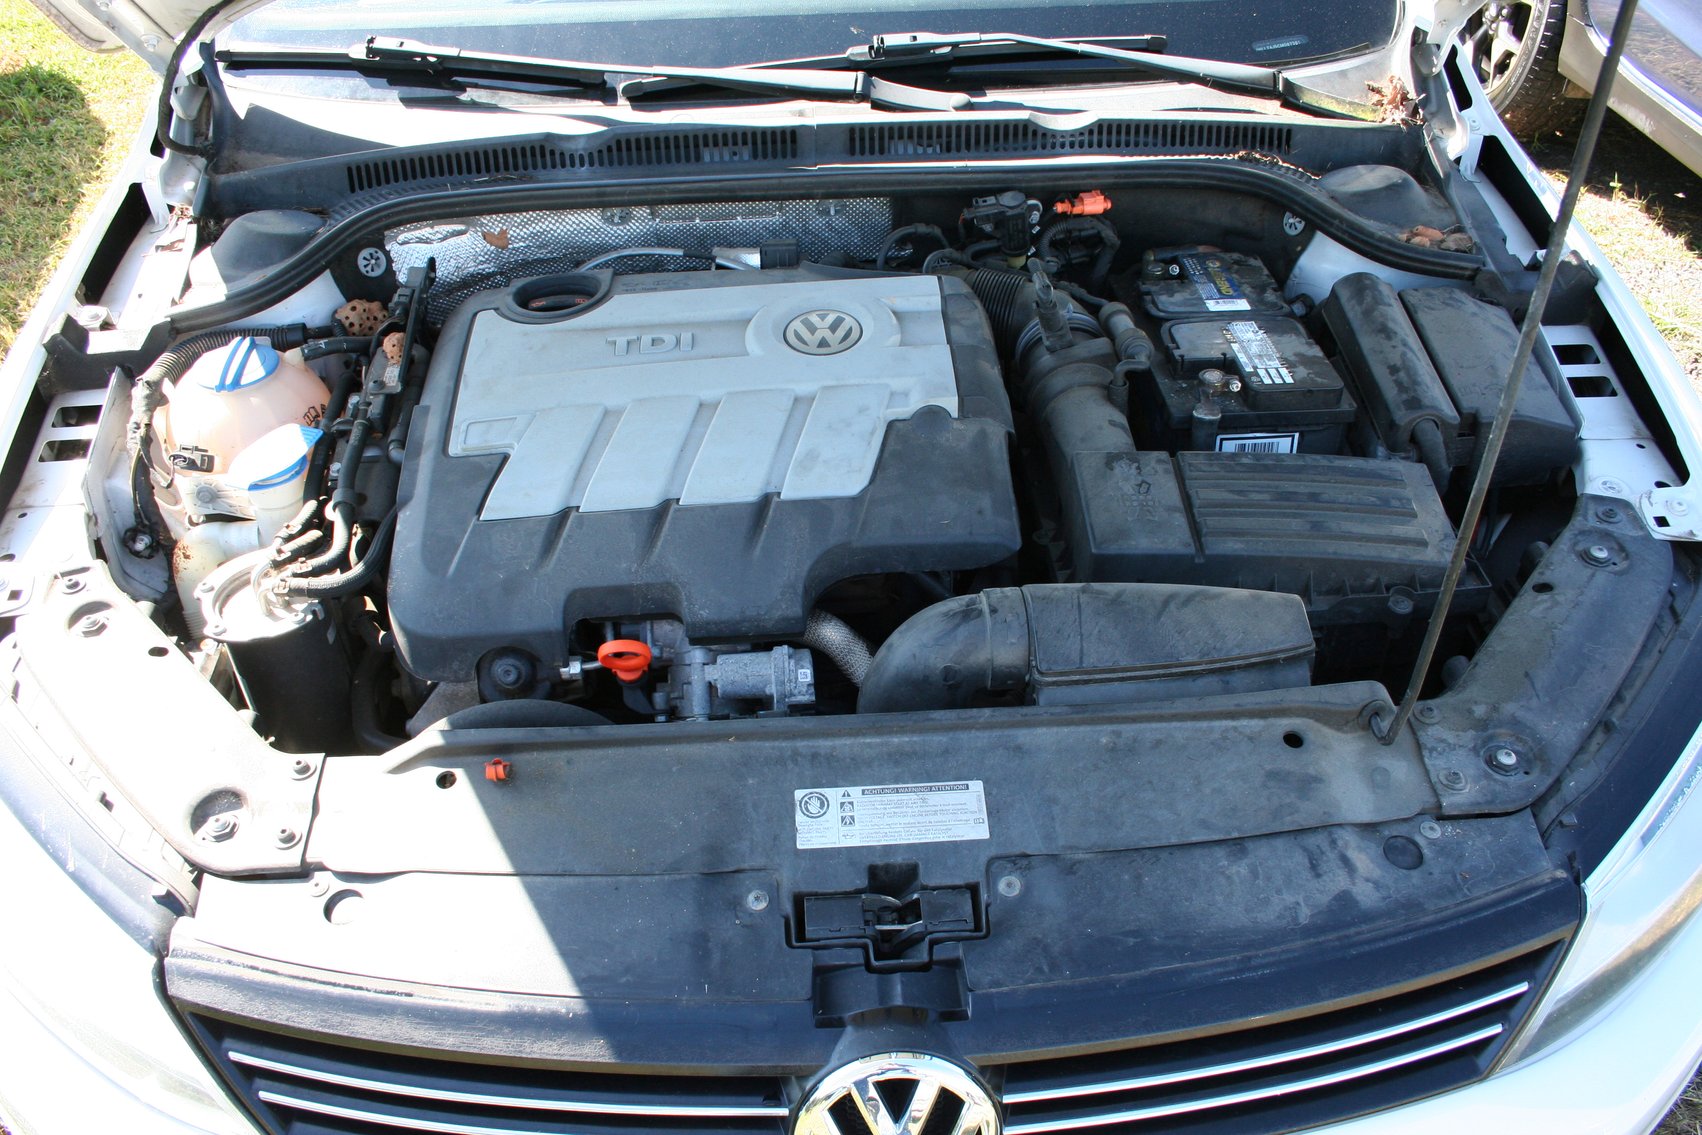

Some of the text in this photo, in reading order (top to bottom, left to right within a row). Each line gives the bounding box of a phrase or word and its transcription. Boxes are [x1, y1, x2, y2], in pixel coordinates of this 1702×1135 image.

[606, 332, 695, 356] TDI
[863, 784, 968, 795] ACHTUNG! WARNING! ATTENTION!
